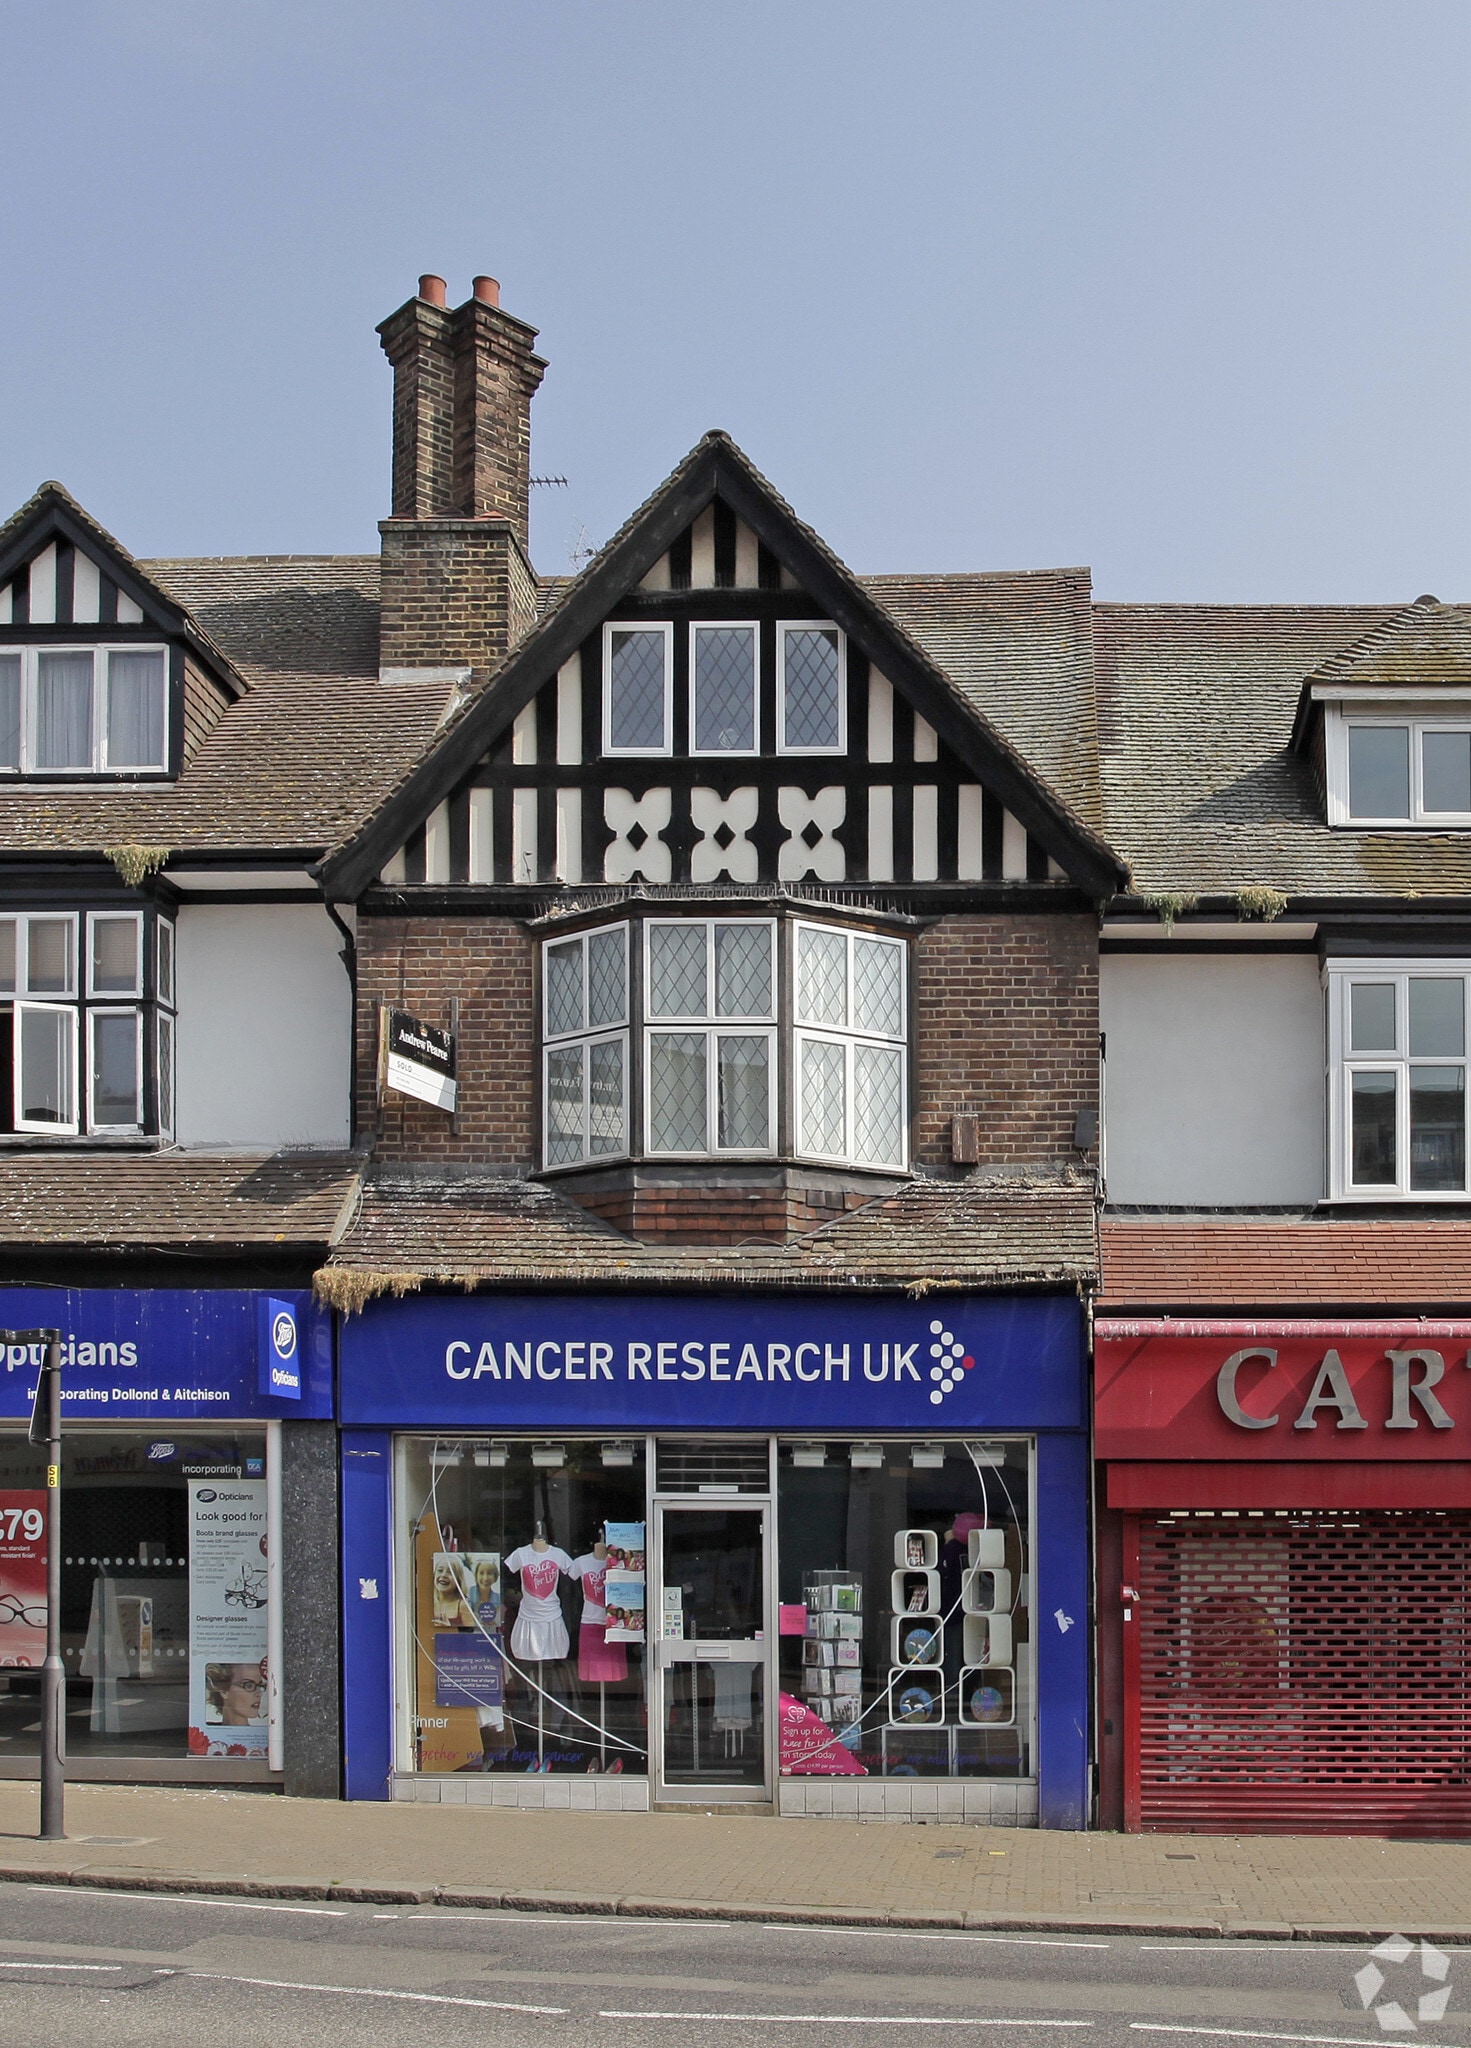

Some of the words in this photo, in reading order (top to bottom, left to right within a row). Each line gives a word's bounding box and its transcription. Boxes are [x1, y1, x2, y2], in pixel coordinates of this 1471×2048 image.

[399, 1029, 427, 1050] Andrew
[426, 1040, 449, 1061] Pearce
[397, 1061, 413, 1073] SOLD
[0, 1333, 138, 1372] ptcians
[445, 1340, 614, 1380] CANCER
[627, 1341, 851, 1382] RESEARCH
[863, 1342, 923, 1382] UK
[272, 1367, 299, 1388] Opticians
[27, 1387, 109, 1402] inporating
[112, 1388, 159, 1401] Dollond
[162, 1389, 171, 1401] &
[174, 1388, 231, 1401] Aitchison
[1216, 1346, 1471, 1430] CAR
[148, 1443, 175, 1459] Boots
[49, 1466, 55, 1475] S
[182, 1463, 242, 1476] incorporating
[49, 1477, 55, 1486] 6
[219, 1492, 254, 1501] Opticians
[196, 1512, 219, 1521] Look
[222, 1512, 247, 1522] good
[250, 1512, 263, 1521] for
[0, 1508, 44, 1541] 79
[235, 1530, 258, 1538] glasses
[528, 1561, 551, 1577] Race
[533, 1574, 545, 1590] for
[588, 1570, 606, 1585] Rac
[224, 1615, 248, 1623] glasses
[409, 1714, 449, 1729] Pinner
[783, 1727, 799, 1737] Sign
[800, 1729, 811, 1737] up
[812, 1726, 824, 1735] for
[783, 1739, 802, 1748] Race
[804, 1738, 816, 1749] for
[467, 1751, 483, 1761] we
[815, 1751, 836, 1760] today
